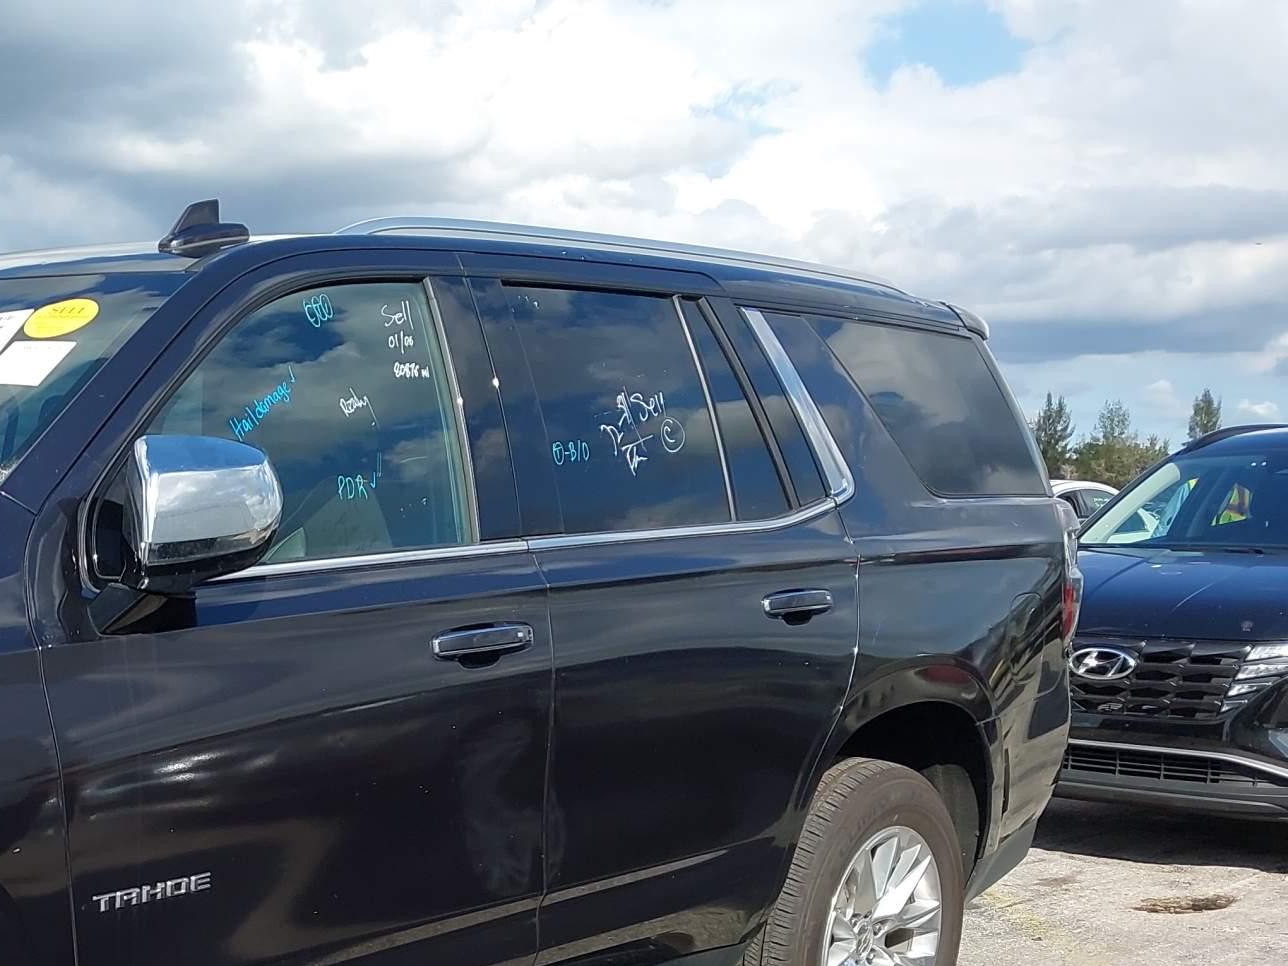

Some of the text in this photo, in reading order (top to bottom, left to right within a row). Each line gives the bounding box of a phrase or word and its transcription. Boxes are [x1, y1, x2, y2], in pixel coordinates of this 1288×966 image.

[380, 301, 414, 330] Sell
[629, 391, 667, 421] Sell
[337, 474, 368, 500] PDR
[92, 872, 212, 913] TAHOE
